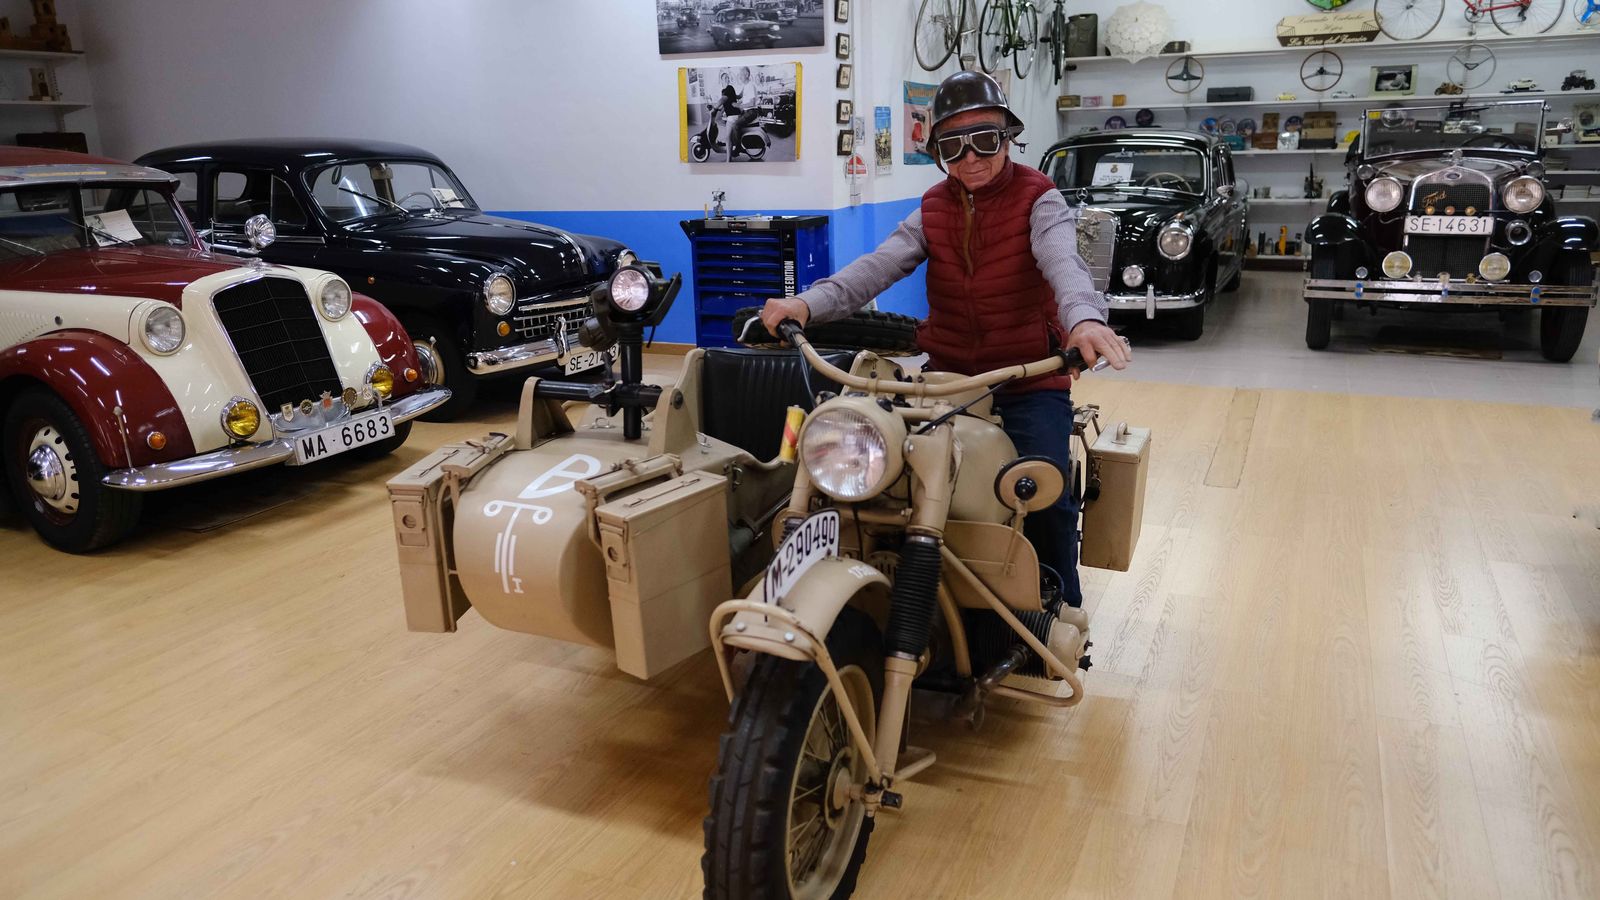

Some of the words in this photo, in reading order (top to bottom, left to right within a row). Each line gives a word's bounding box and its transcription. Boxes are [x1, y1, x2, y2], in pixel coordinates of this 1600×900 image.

[1410, 217, 1487, 232] SE-14631
[784, 260, 795, 285] EDITION
[771, 515, 836, 598] M-290490
